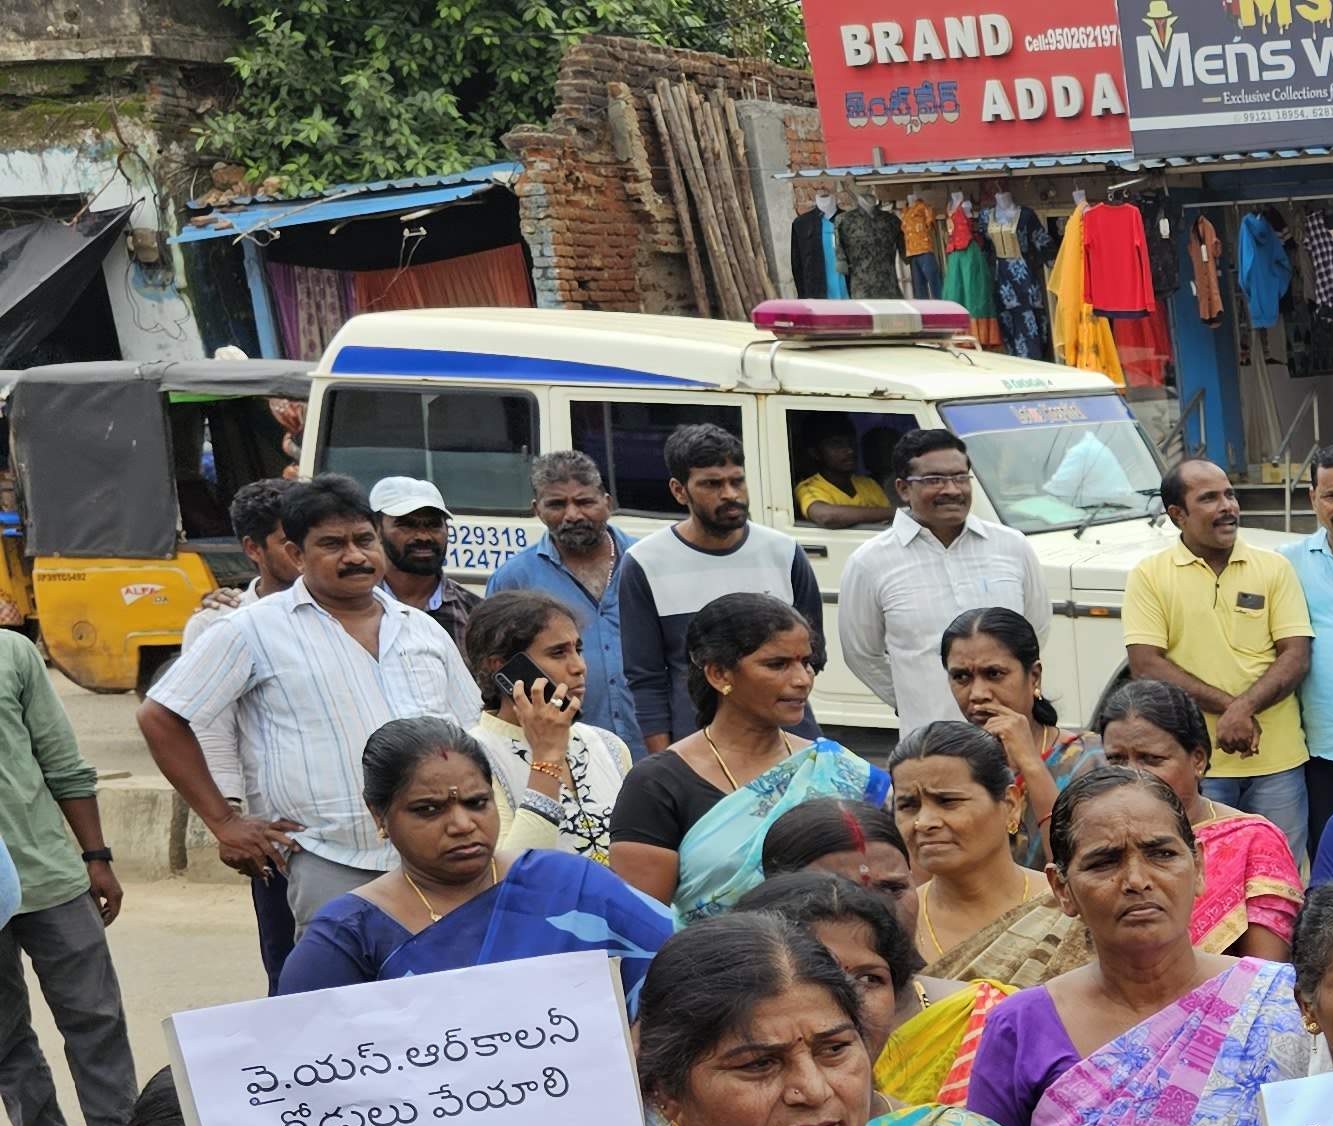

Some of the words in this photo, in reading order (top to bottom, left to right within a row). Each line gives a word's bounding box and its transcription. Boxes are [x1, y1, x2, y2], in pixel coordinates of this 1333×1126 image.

[840, 14, 1014, 67] BRAND
[981, 73, 1126, 122] ADDA
[1223, 89, 1271, 105] Exclusive
[1272, 85, 1328, 102] Collections
[427, 1065, 570, 1120] వేయాలి
